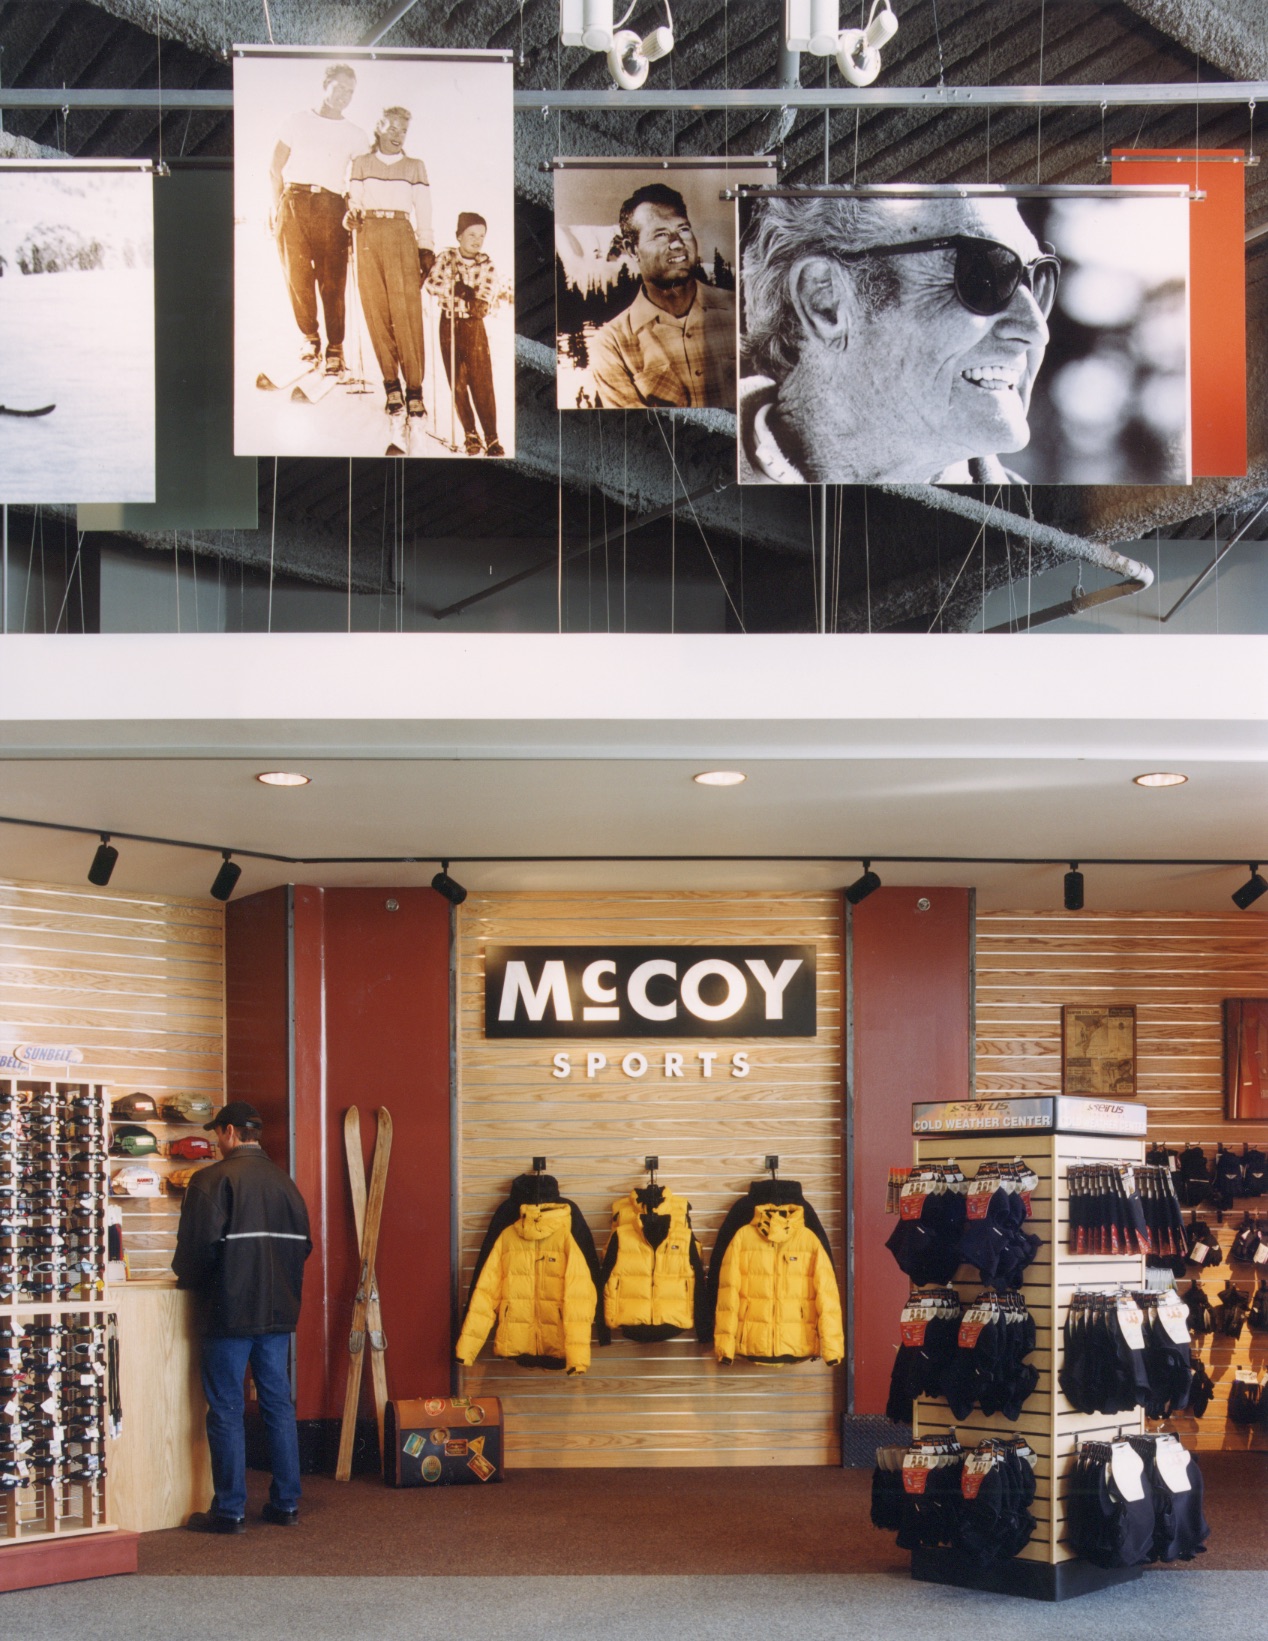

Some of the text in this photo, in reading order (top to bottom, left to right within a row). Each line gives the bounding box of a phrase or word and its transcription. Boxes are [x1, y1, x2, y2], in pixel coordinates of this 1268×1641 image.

[0, 1055, 22, 1069] BELT
[23, 1047, 73, 1062] SUNBELT
[552, 1052, 750, 1078] SPORTS
[913, 1115, 1051, 1131] COLD WEATHER CENTER
